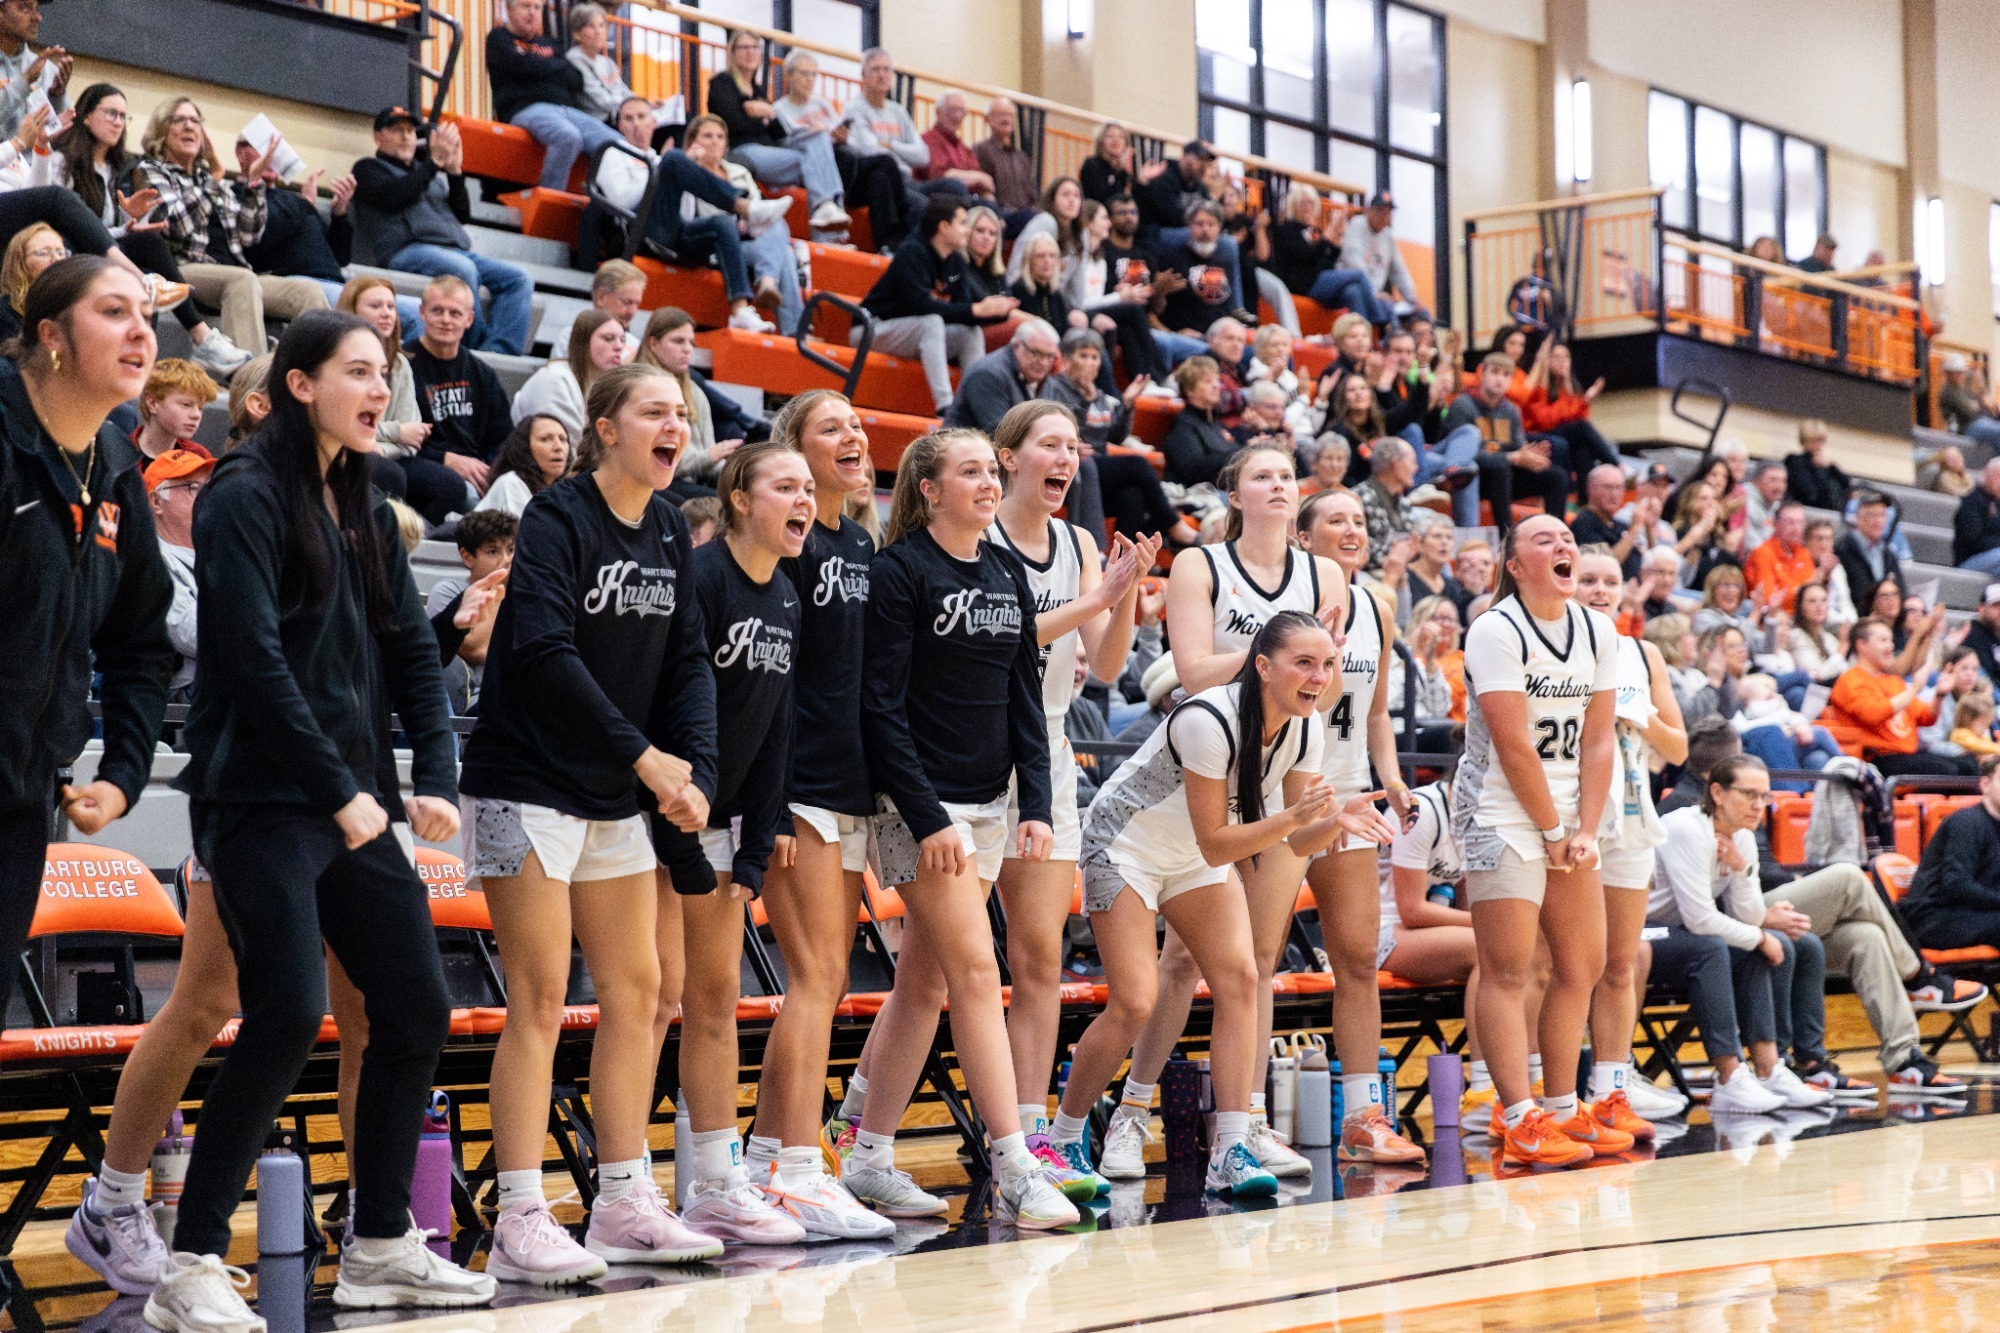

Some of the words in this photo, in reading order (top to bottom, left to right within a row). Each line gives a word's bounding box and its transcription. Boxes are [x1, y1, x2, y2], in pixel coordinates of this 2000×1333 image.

[1342, 651, 1377, 684] tburg
[1327, 691, 1355, 742] 4
[1534, 715, 1579, 762] 20
[44, 860, 143, 878] ARTBURG
[417, 863, 467, 880] BURG
[42, 879, 139, 898] COLLEGE
[32, 1031, 118, 1053] KNIGHTS
